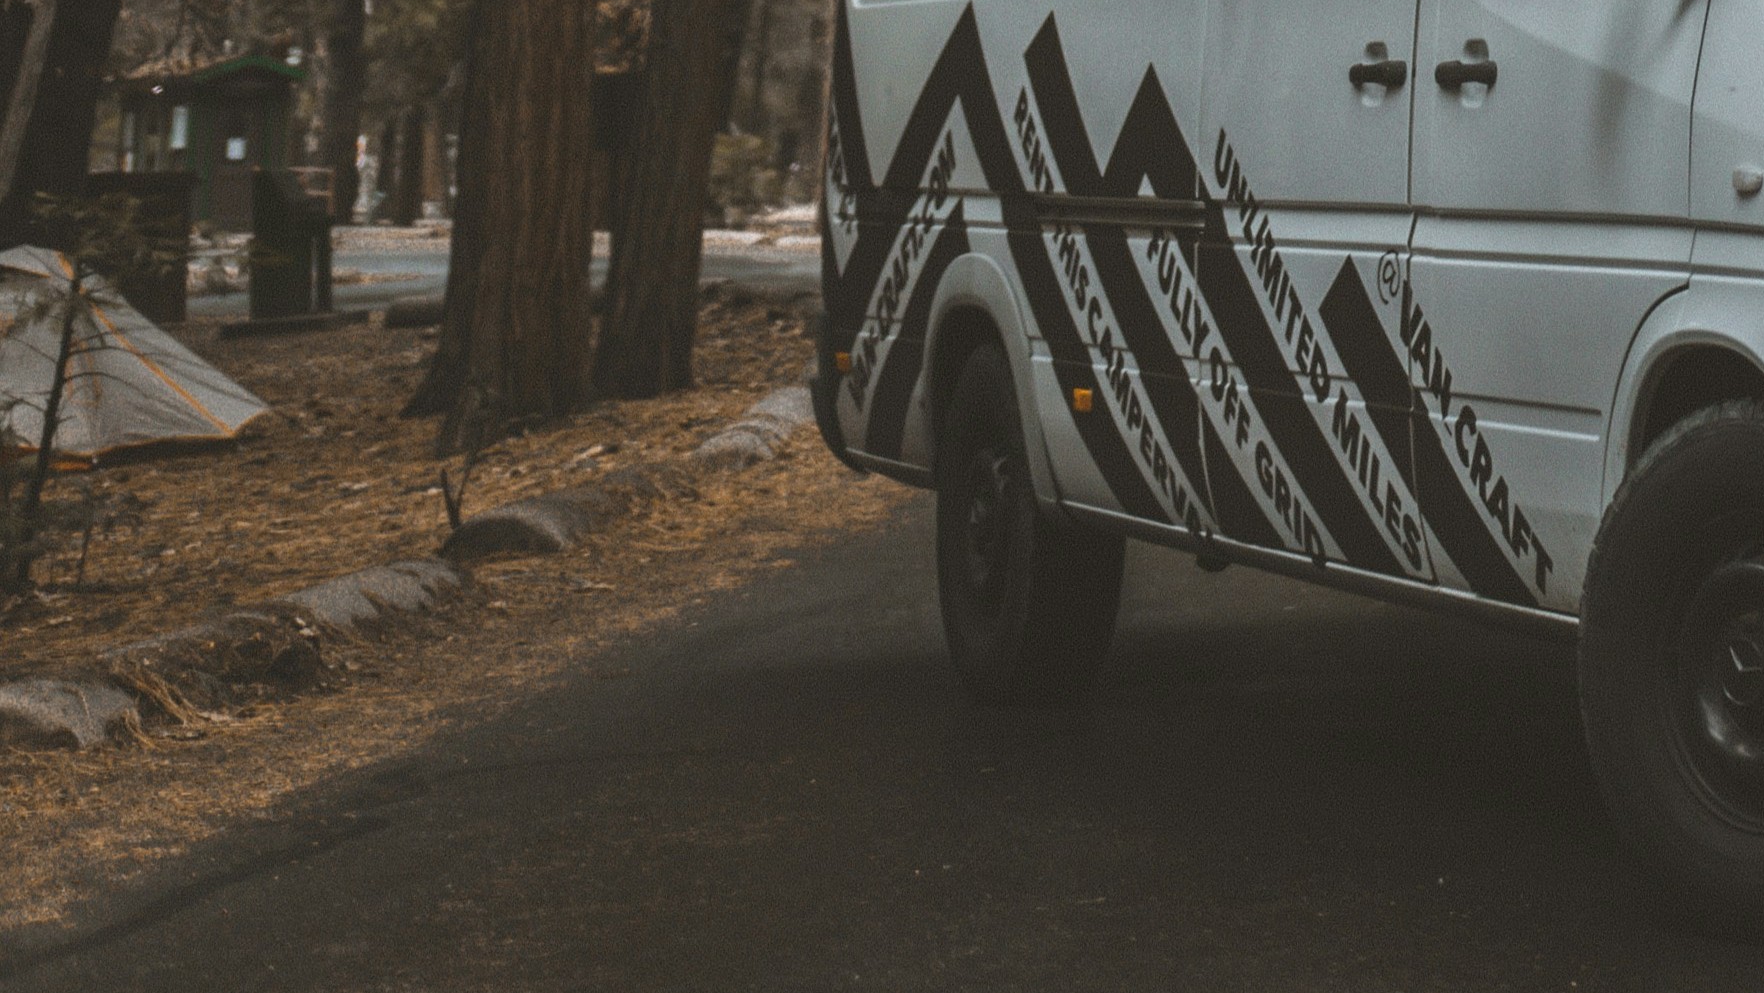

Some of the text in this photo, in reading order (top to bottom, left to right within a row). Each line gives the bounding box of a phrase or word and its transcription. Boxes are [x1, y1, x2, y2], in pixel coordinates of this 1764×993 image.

[1087, 296, 1213, 538] CAMPERVA
[1147, 228, 1327, 568] FULLY OFF GRID
[1214, 127, 1422, 571] UNLIMITED MILES
